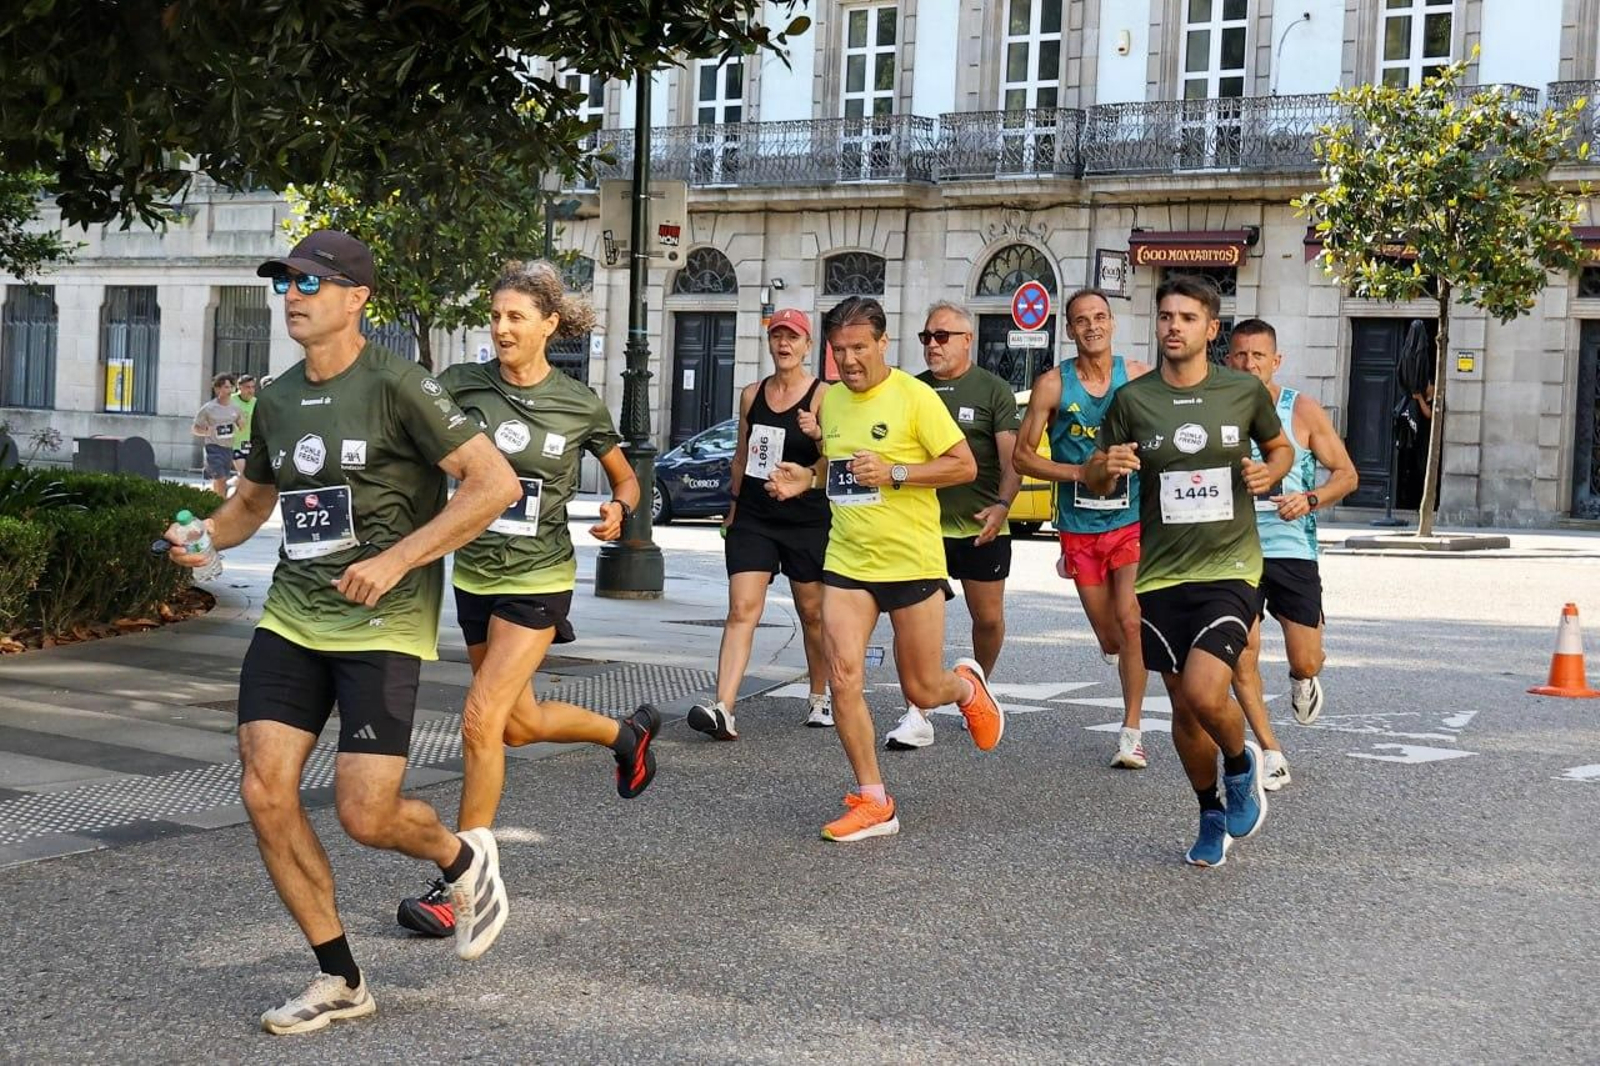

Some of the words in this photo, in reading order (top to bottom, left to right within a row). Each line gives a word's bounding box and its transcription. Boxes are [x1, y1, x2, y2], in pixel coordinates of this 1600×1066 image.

[758, 436, 768, 469] 1086
[838, 473, 859, 485] 13
[1174, 485, 1219, 500] 1445
[295, 510, 331, 528] 272
